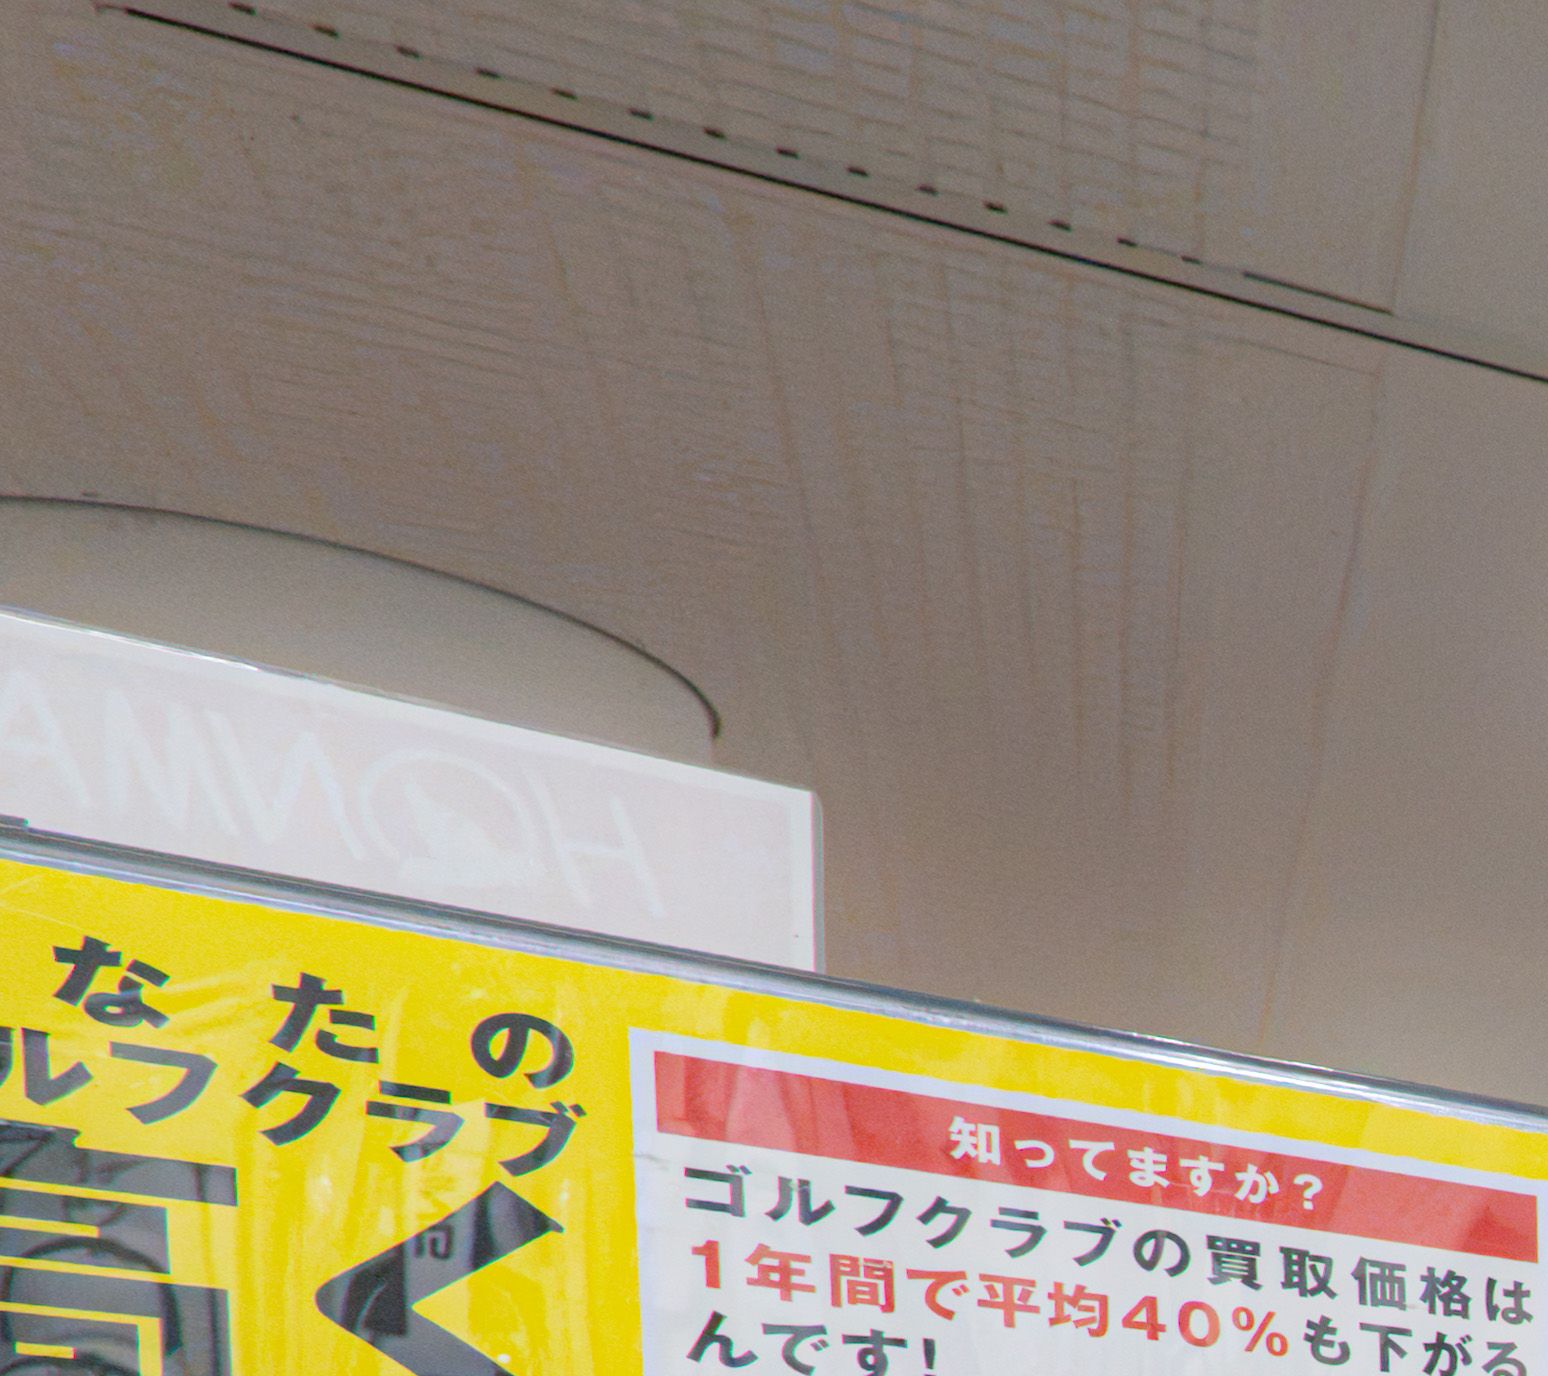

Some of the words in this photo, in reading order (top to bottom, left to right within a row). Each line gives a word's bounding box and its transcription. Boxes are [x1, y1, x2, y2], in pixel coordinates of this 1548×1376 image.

[52, 935, 575, 1089] なたの
[947, 1116, 1324, 1211] 知ってますか?
[683, 1163, 1533, 1325] ゴルフクラブの買取価格は
